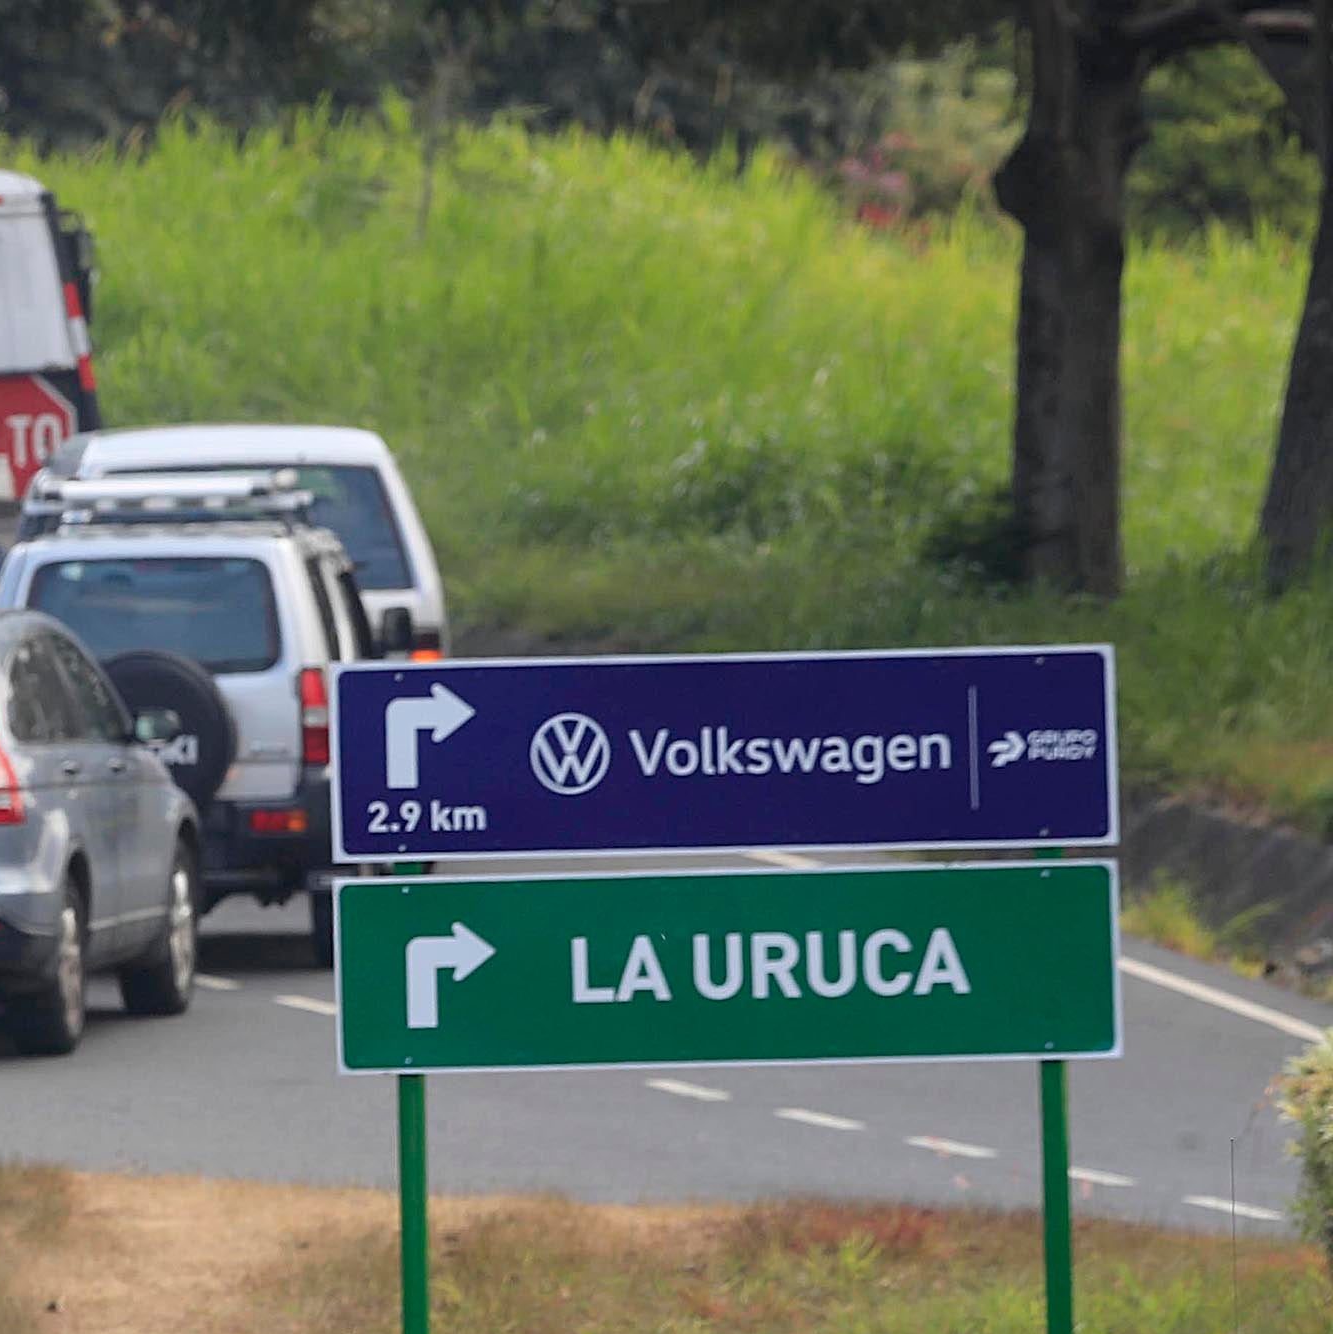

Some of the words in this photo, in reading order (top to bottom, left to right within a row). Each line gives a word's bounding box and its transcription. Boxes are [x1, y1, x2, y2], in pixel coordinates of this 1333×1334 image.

[629, 725, 953, 784] Volkswagen
[367, 800, 423, 834] 2.9
[430, 798, 488, 832] km
[570, 934, 673, 1004] LA
[691, 926, 972, 1001] URUCA
